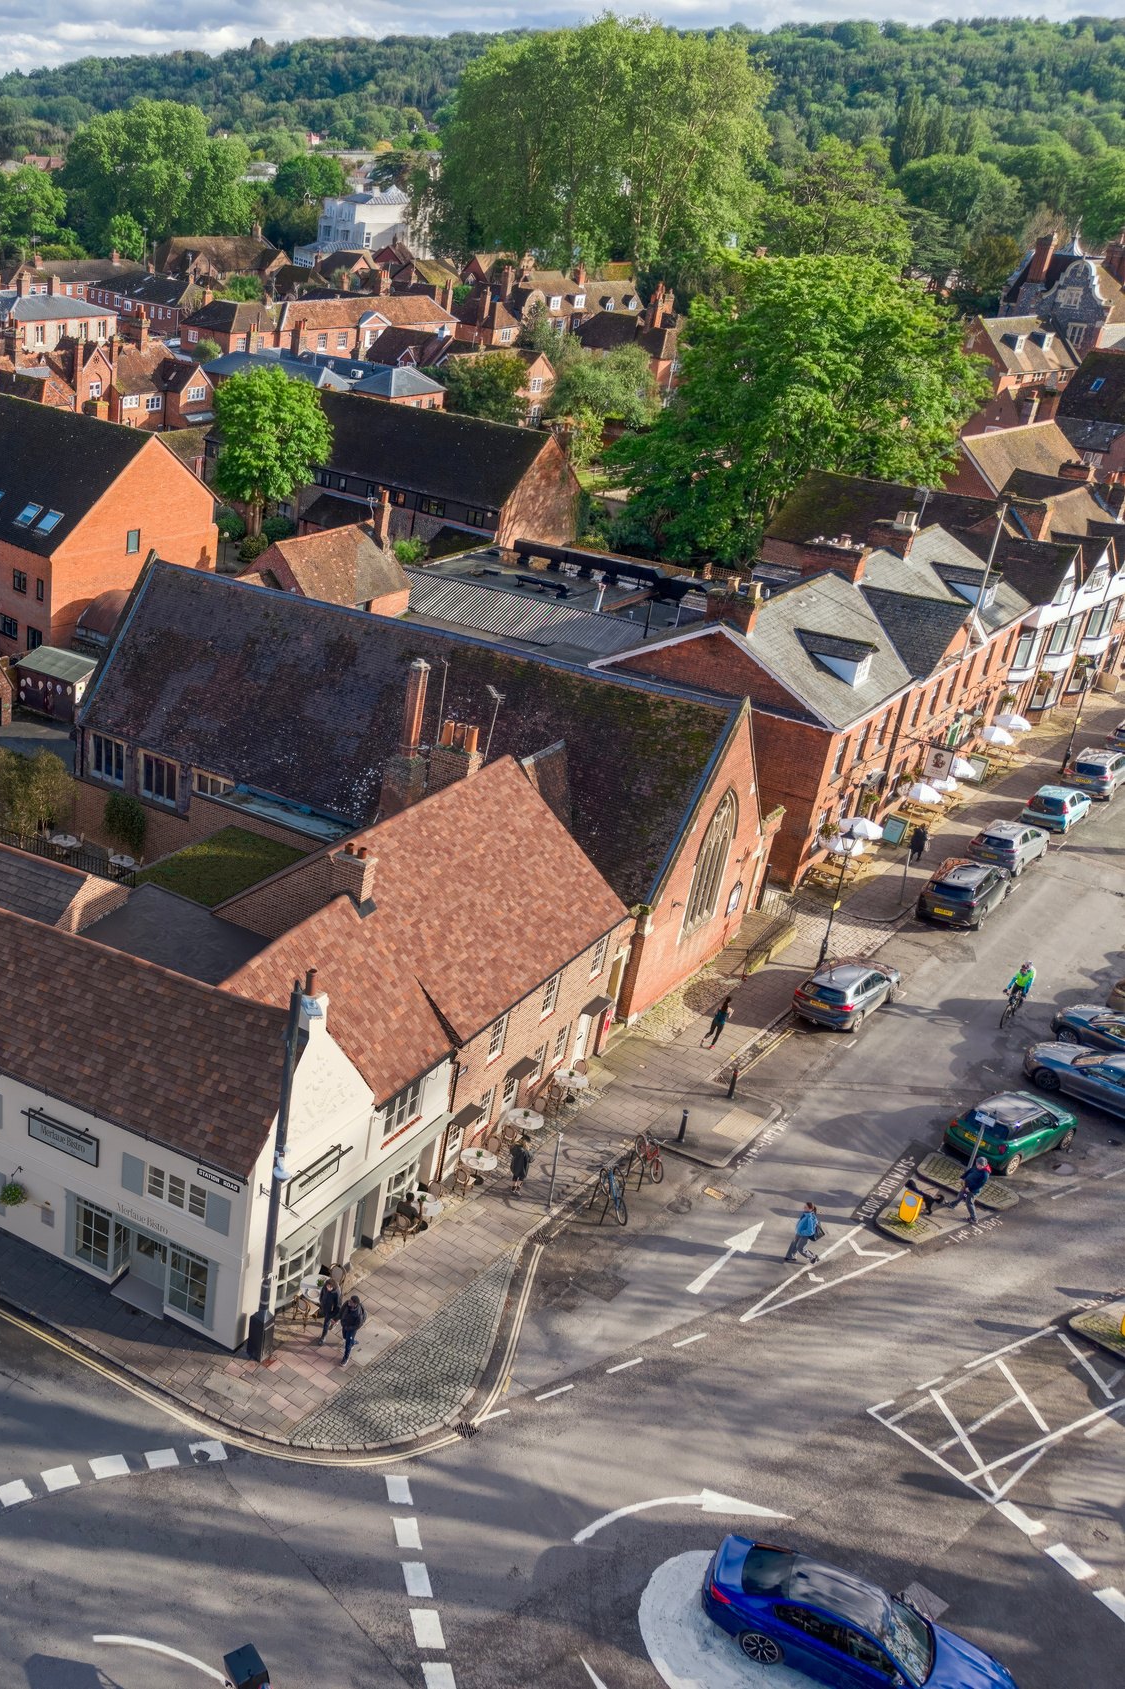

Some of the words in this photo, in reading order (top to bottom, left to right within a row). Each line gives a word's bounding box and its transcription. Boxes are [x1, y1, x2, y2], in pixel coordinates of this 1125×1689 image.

[66, 1136, 86, 1154] Bistro
[198, 1169, 220, 1183] STATION
[222, 1180, 239, 1191] ROAD
[856, 1196, 885, 1219] LOOK
[888, 1159, 916, 1180] WAYS
[146, 1216, 169, 1235] Bistro
